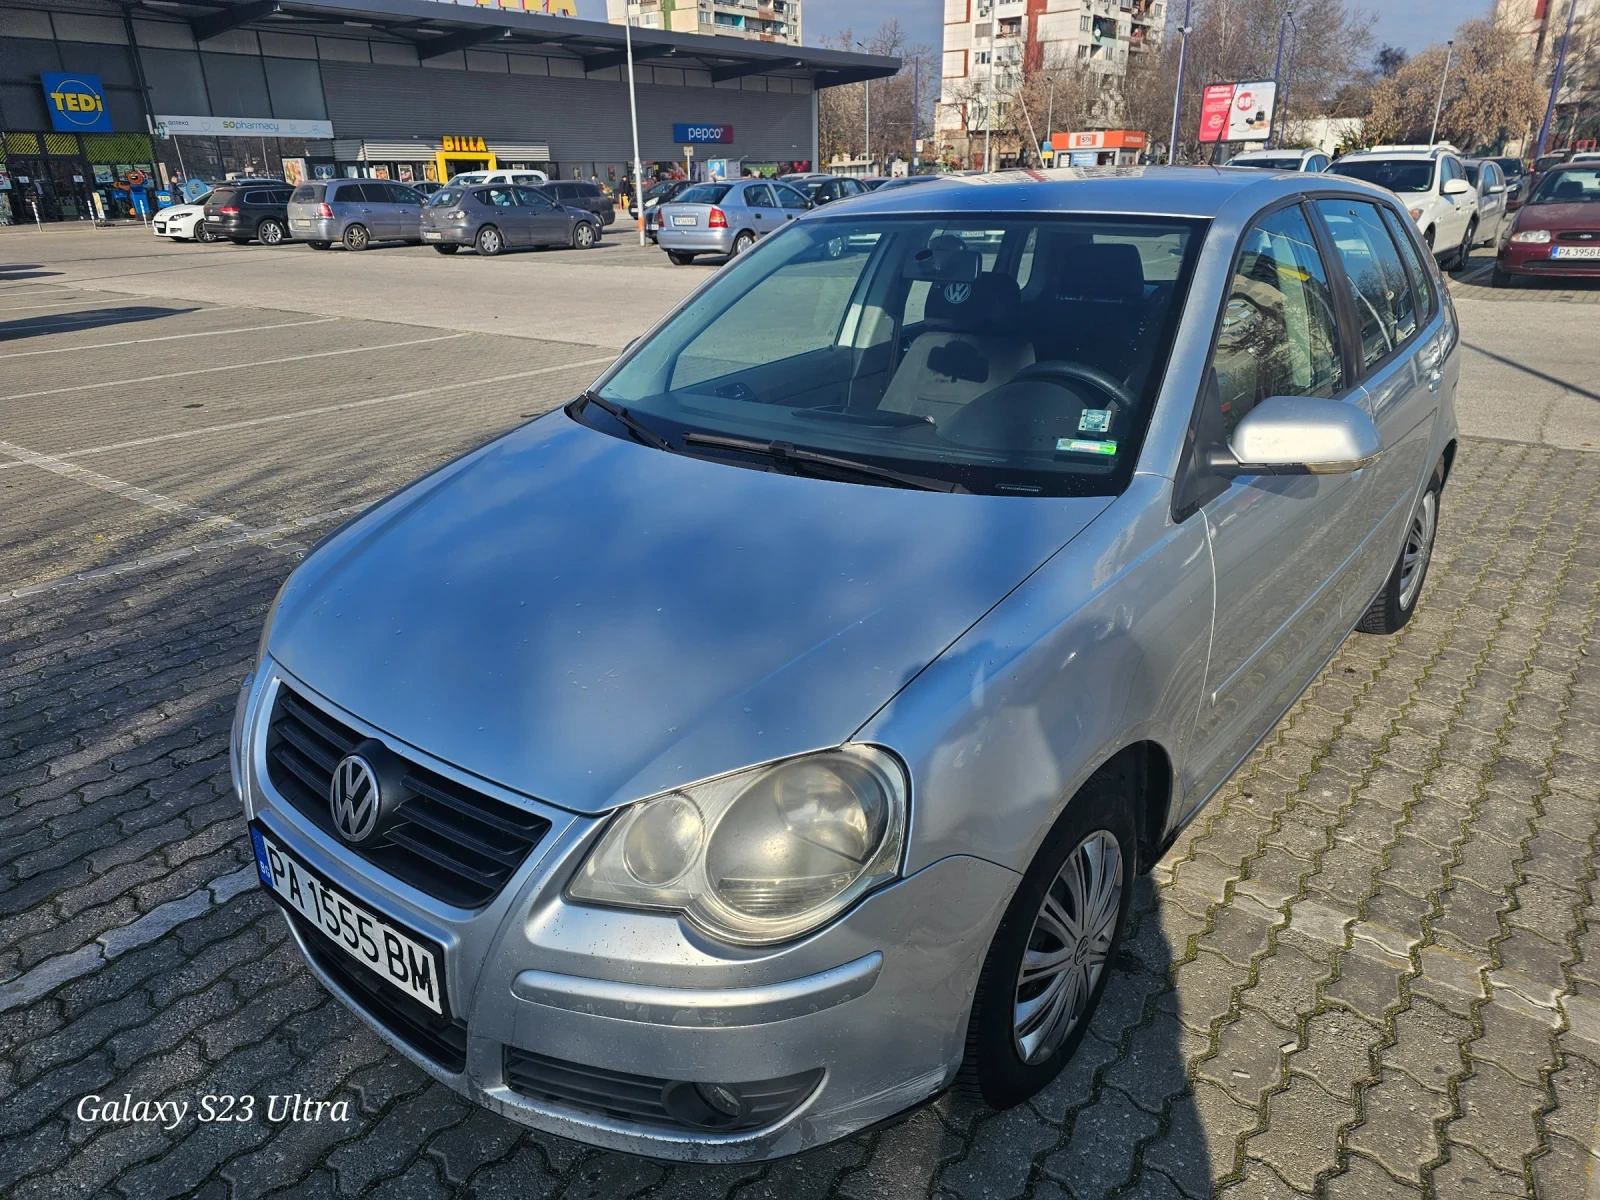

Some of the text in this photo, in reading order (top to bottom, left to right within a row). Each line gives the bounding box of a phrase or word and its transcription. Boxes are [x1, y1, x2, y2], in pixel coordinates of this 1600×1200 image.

[50, 92, 103, 112] TEDi
[688, 127, 721, 140] pepco
[442, 135, 487, 151] BILLA
[1558, 248, 1571, 257] PA
[1572, 248, 1596, 257] 3958
[260, 861, 271, 878] BG
[267, 844, 435, 1003] PA 1555 BM
